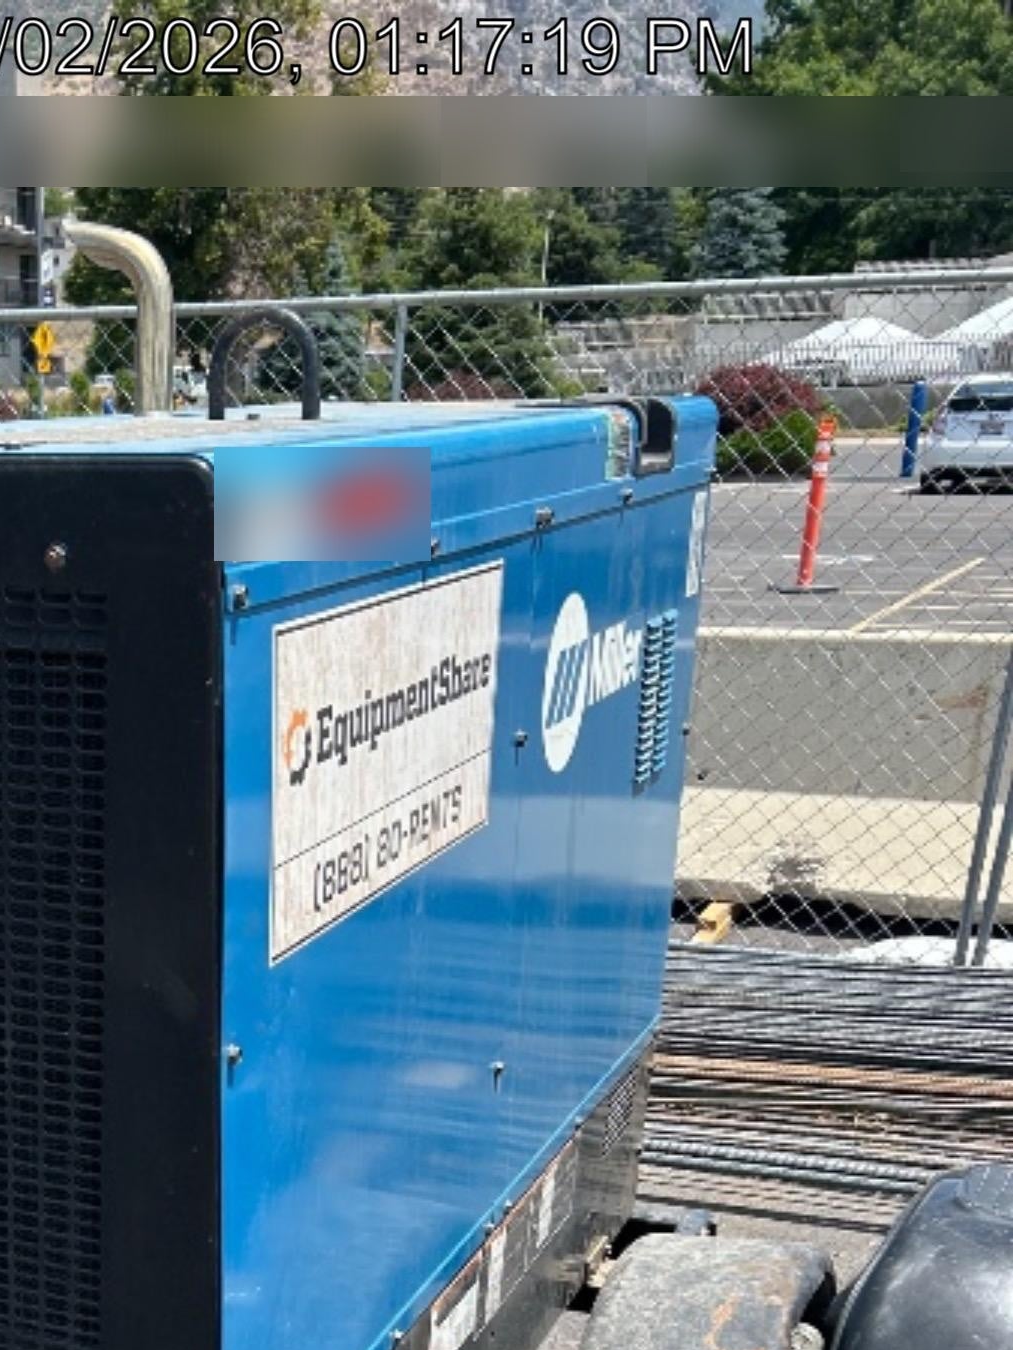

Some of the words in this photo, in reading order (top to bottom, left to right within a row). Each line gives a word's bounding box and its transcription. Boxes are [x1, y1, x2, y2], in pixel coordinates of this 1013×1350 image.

[316, 652, 492, 766] EquipmentShare
[313, 832, 370, 912] (888)
[376, 784, 463, 869] 80-RENTS
